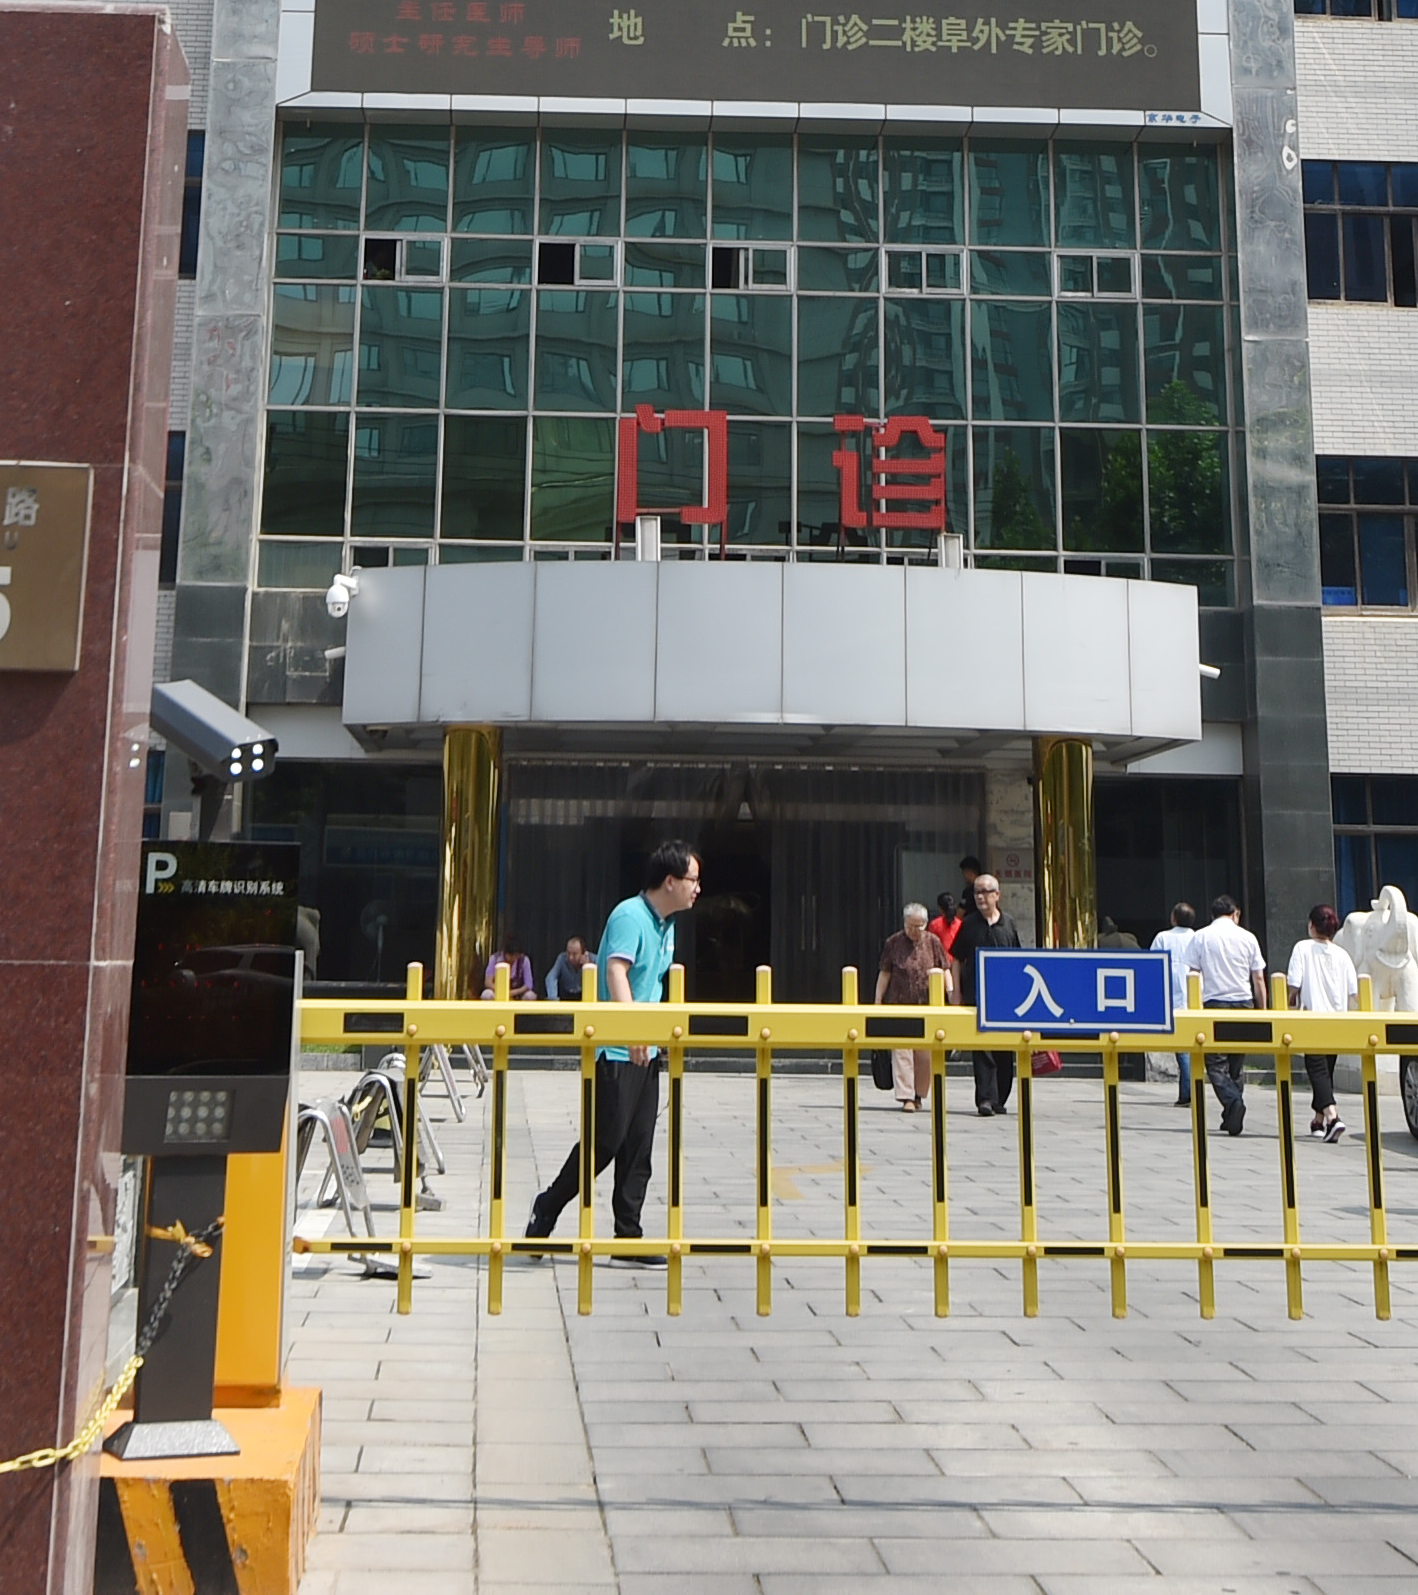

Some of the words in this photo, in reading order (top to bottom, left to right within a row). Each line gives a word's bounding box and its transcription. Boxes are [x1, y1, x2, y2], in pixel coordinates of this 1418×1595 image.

[799, 15, 1158, 59] 门诊二楼阜外专家门诊。
[615, 404, 946, 530] 门诊
[145, 851, 179, 895] P
[1014, 964, 1136, 1018] 入口
